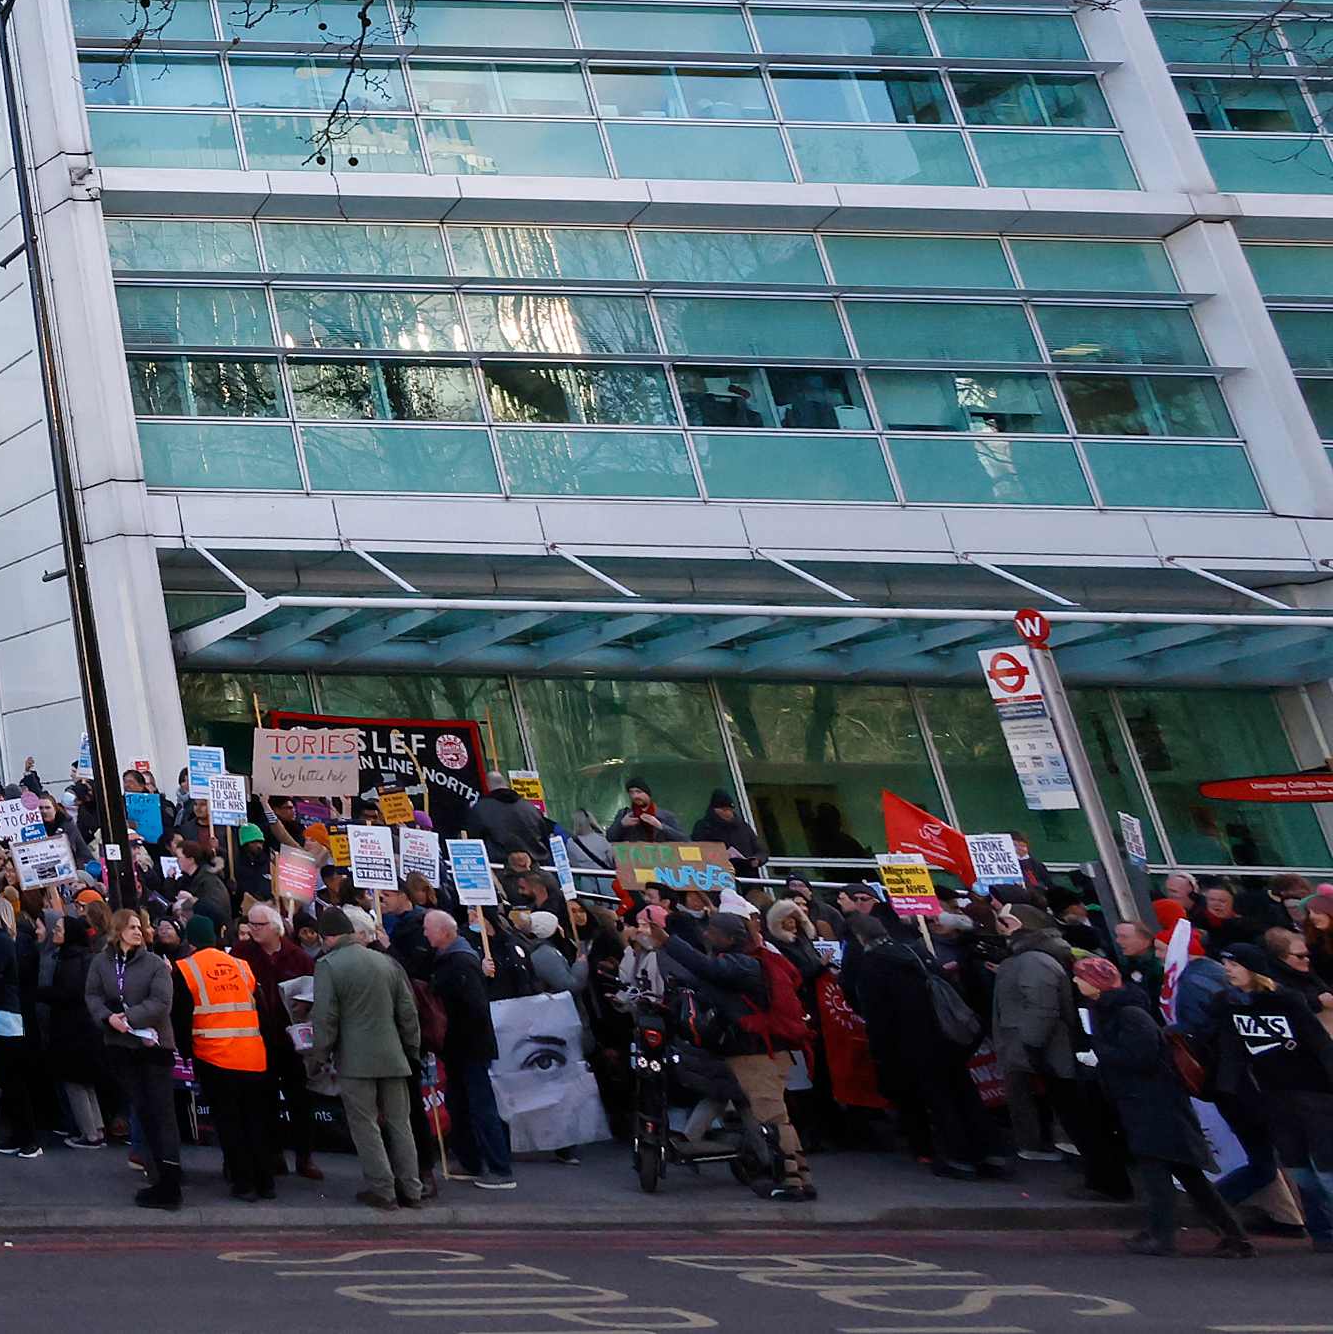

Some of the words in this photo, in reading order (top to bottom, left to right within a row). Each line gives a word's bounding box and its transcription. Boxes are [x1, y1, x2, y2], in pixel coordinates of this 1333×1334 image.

[1016, 617, 1041, 637] W
[266, 734, 356, 754] TORIES
[210, 780, 237, 790] STRIKE
[378, 758, 413, 775] LINE
[421, 767, 480, 807] NORTH
[211, 790, 221, 800] TO
[223, 790, 243, 800] SAVE
[9, 802, 20, 812] BE
[212, 800, 226, 810] THE
[228, 800, 245, 811] NHS
[4, 815, 18, 827] TO
[20, 811, 41, 825] CARE
[970, 840, 1004, 852] STRIKE
[973, 853, 986, 863] TO
[989, 852, 1013, 864] SAVE
[357, 869, 392, 880] STRIKE
[883, 866, 925, 877] Migrants
[977, 865, 995, 875] THE
[998, 864, 1018, 875] NHS
[653, 864, 735, 891] NURSES
[907, 884, 928, 895] NHS
[1236, 1016, 1286, 1037] NHS
[217, 1249, 719, 1329] STOP
[648, 1254, 1137, 1317] BUS
